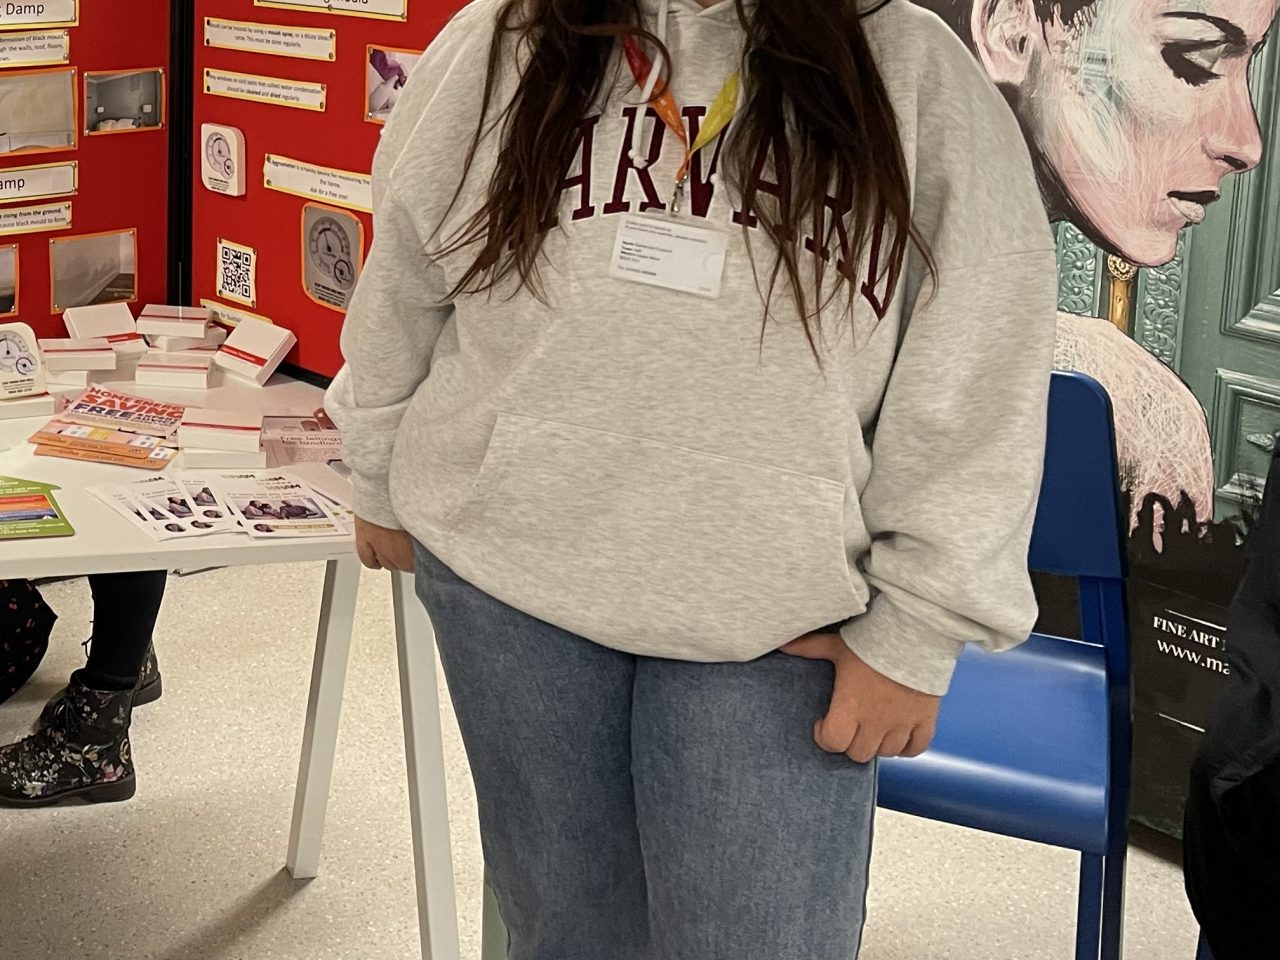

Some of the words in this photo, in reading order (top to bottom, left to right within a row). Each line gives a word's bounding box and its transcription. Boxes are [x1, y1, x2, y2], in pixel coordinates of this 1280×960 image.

[5, 1, 46, 20] Damp
[510, 106, 907, 321] ARVARD
[81, 393, 185, 419] SAVING
[89, 386, 133, 403] HOME
[73, 402, 133, 418] FREE
[1153, 616, 1187, 638] FINE
[1189, 629, 1220, 649] ART
[1156, 639, 1231, 676] www.ma
